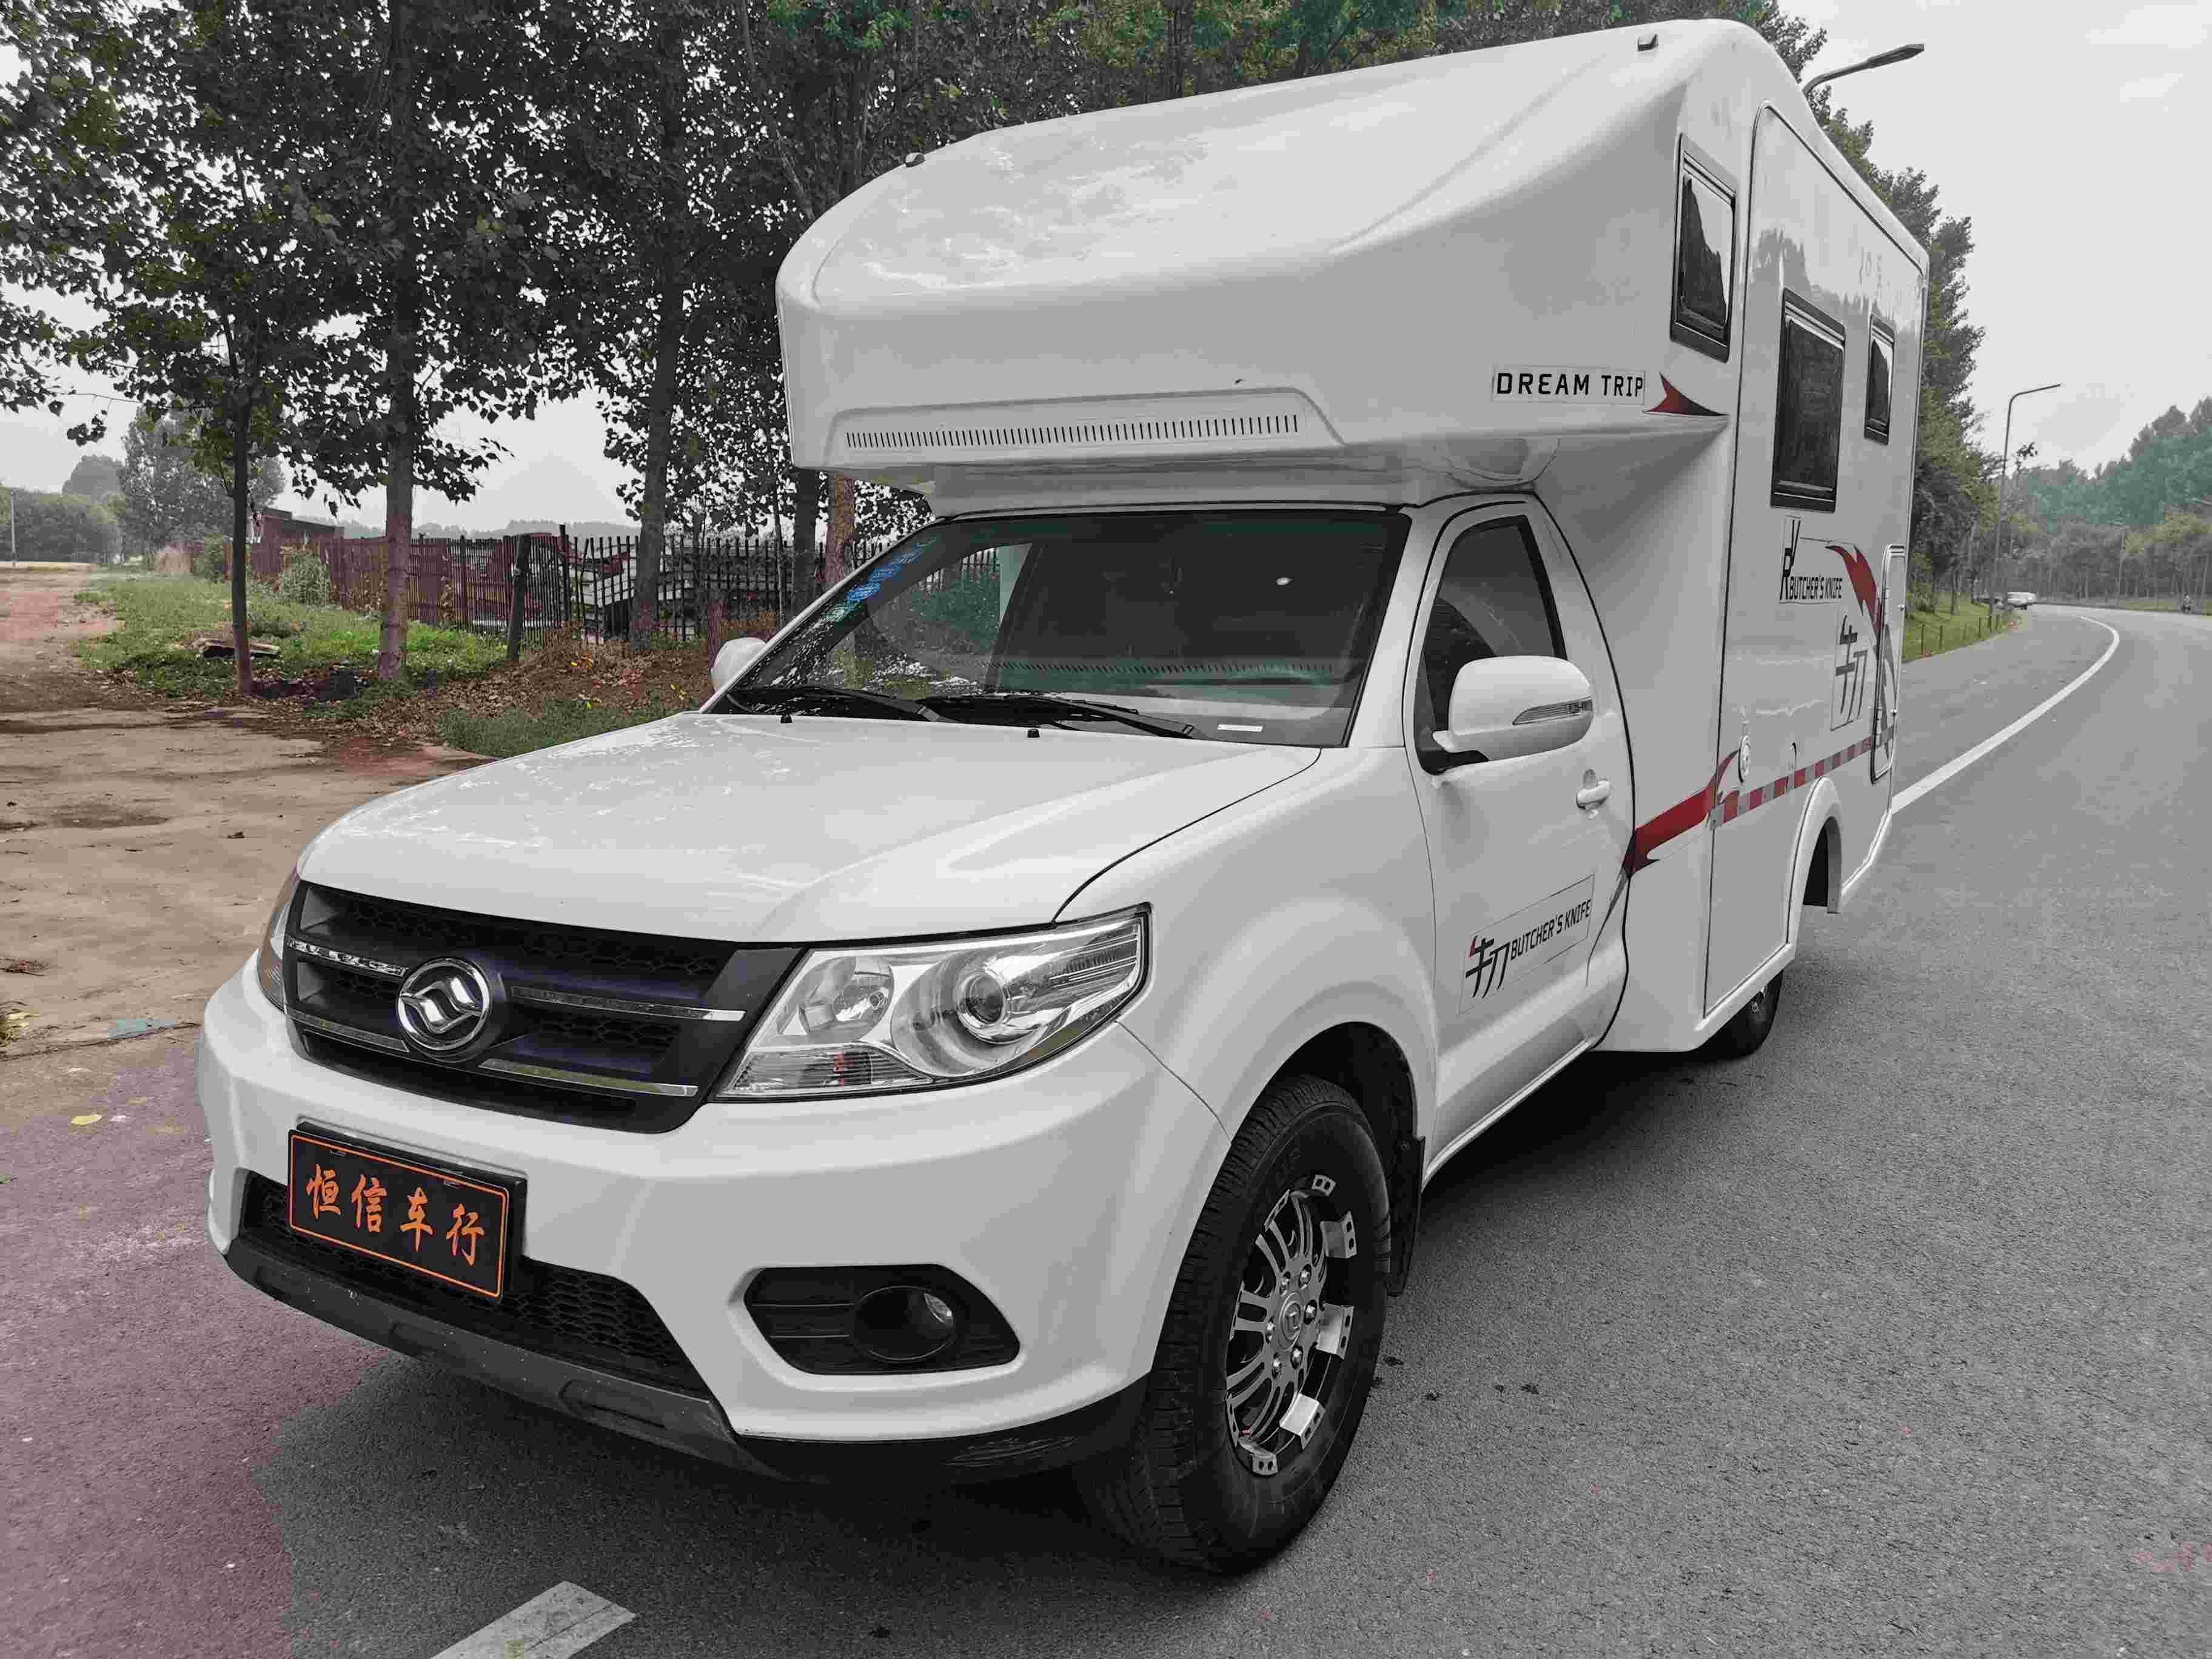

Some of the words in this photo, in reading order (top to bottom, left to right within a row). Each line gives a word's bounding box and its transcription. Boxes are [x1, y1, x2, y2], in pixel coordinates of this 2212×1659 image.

[1496, 372, 1590, 395] DREAM
[1601, 375, 1644, 397] TRIP
[1789, 575, 1825, 600] BUTCHER'S
[1825, 577, 1843, 600] KNIFE
[1510, 914, 1563, 960] BUTCHER'S
[1564, 899, 1592, 930] KNIFE
[306, 1164, 485, 1267] 恒信车行
